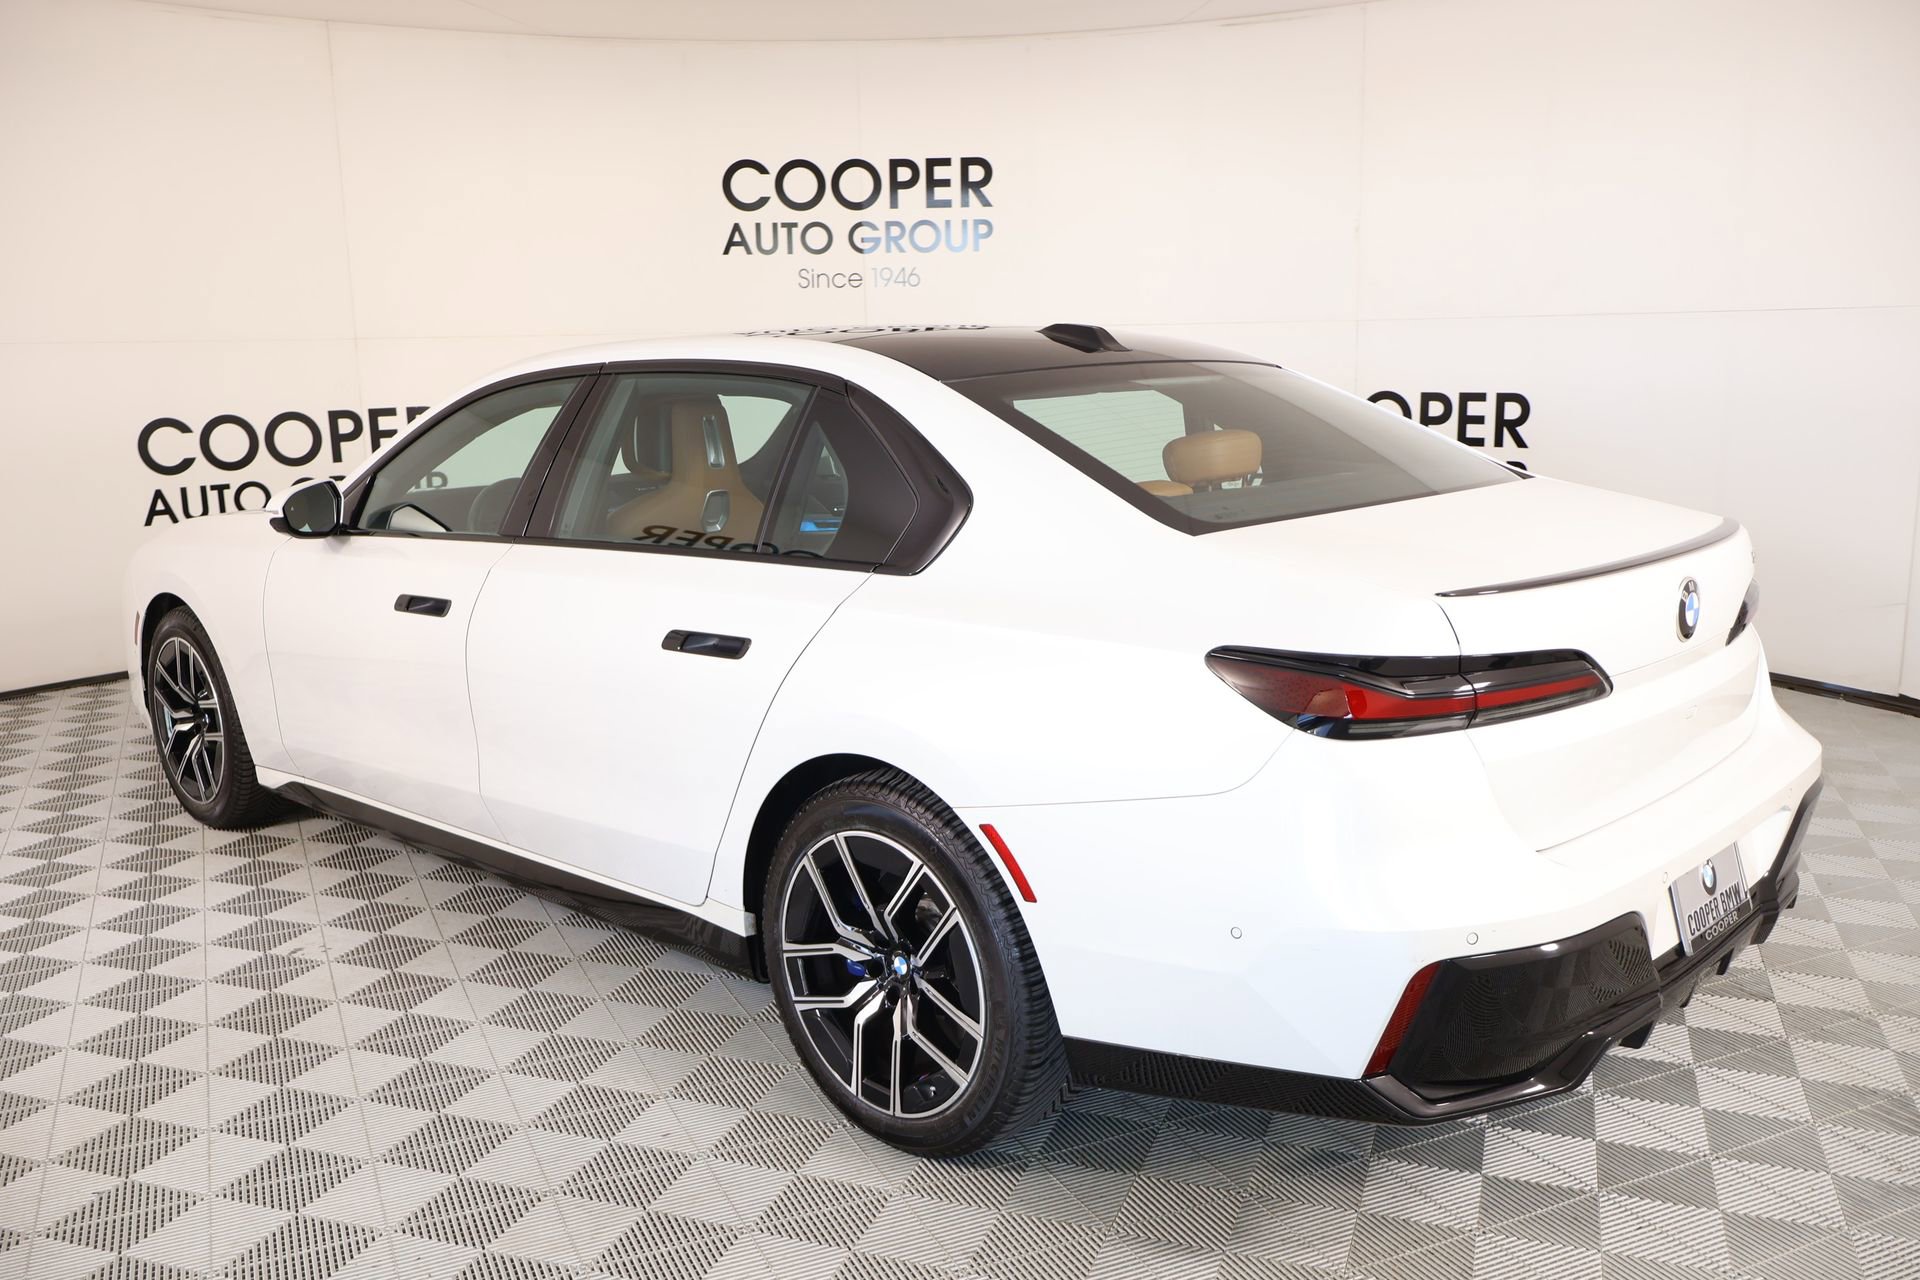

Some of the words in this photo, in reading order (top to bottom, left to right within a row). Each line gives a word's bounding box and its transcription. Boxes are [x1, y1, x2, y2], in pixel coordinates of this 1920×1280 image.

[722, 157, 993, 212] COOPER
[722, 221, 834, 255] AUTO
[848, 219, 994, 254] GROUP
[798, 268, 863, 288] Since
[871, 266, 921, 288] 1946
[138, 405, 432, 476] COOPE
[144, 481, 272, 527] AUTO
[1688, 898, 1720, 936] COOPER
[1720, 882, 1741, 912] BMW
[1706, 912, 1739, 940] COOPER
